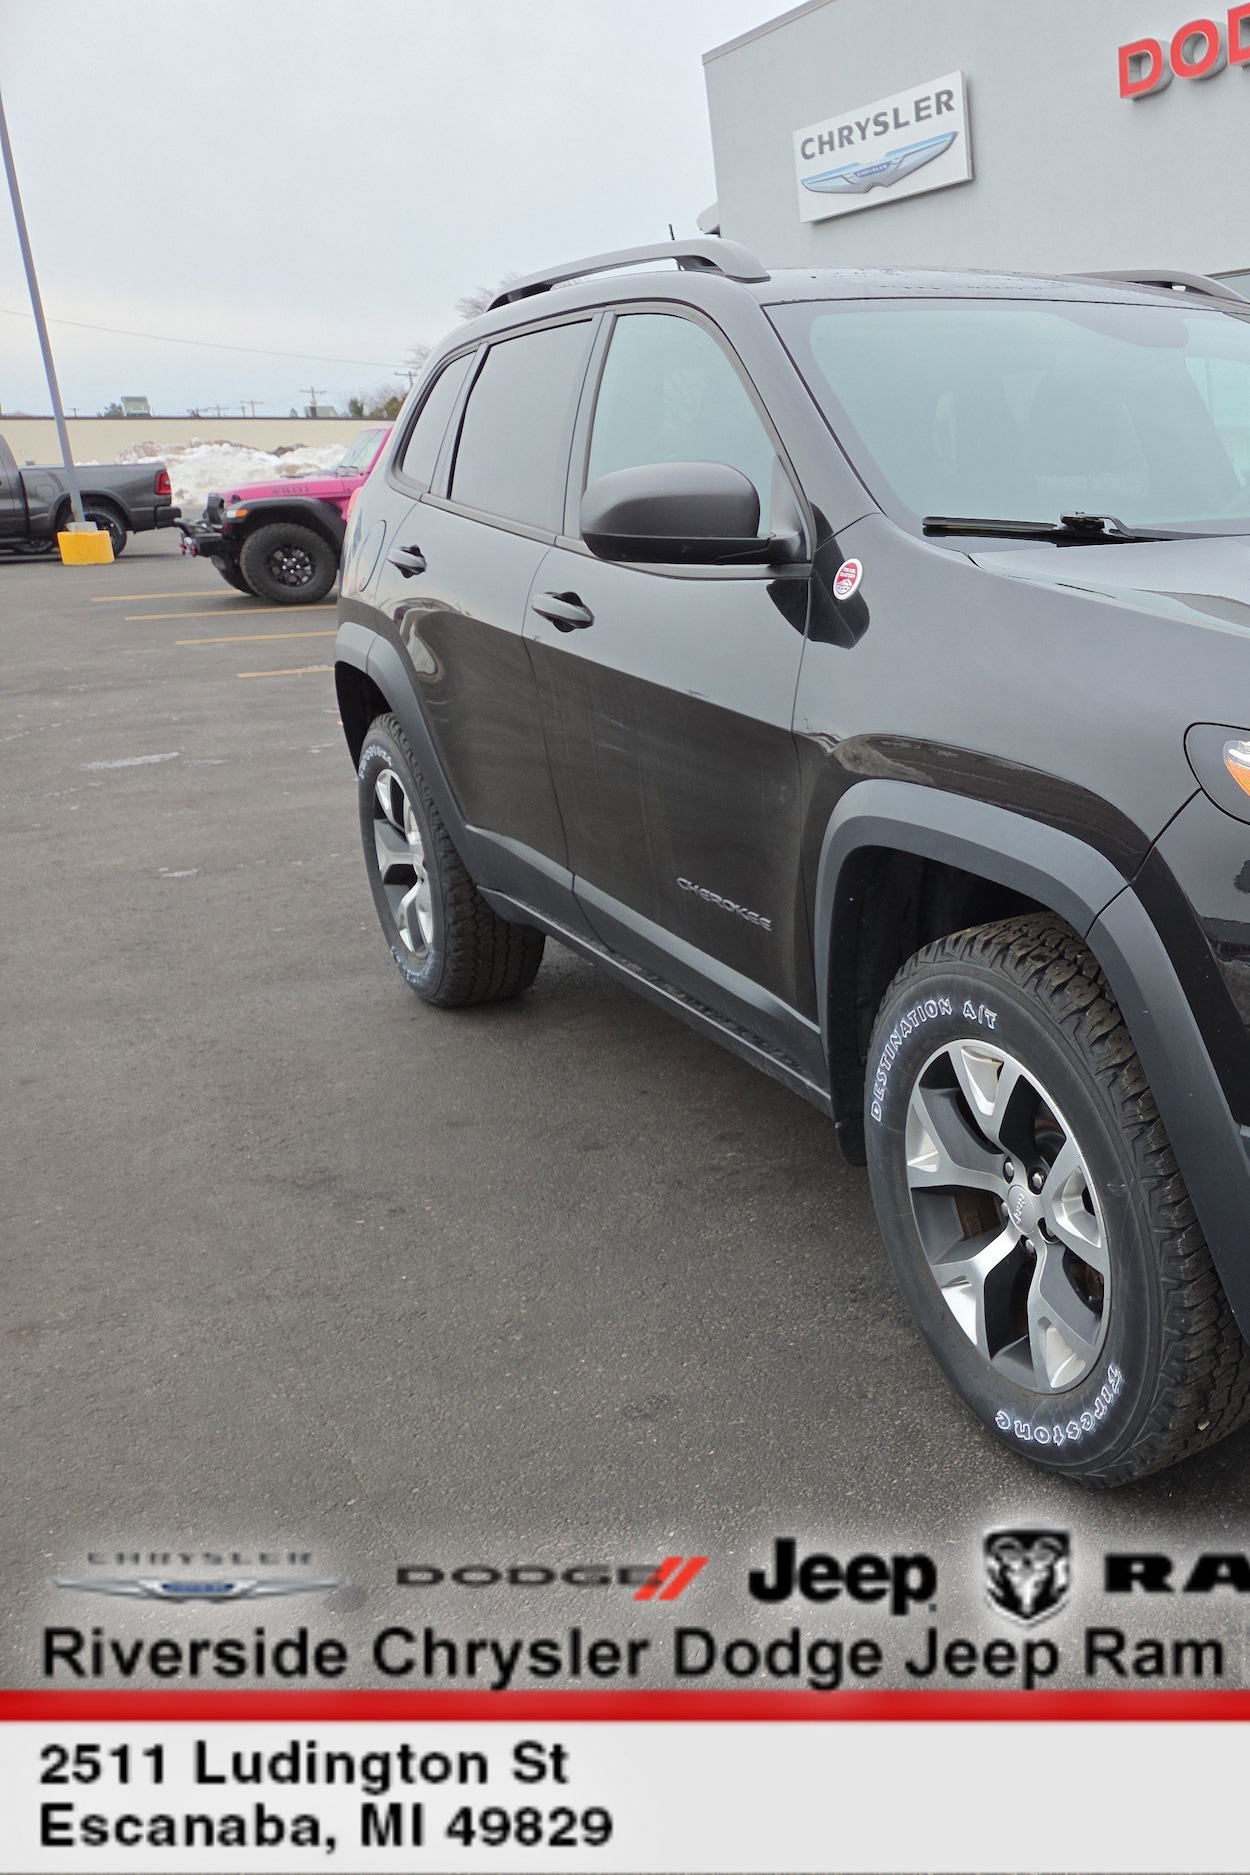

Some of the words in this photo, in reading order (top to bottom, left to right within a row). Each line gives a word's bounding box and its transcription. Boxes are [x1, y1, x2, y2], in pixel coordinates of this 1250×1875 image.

[800, 88, 956, 161] CHRYSLER
[676, 877, 773, 932] CHEROKEE
[870, 997, 952, 1122] DESTINATION
[962, 1000, 998, 1029] A/T
[994, 1363, 1123, 1447] Firestone
